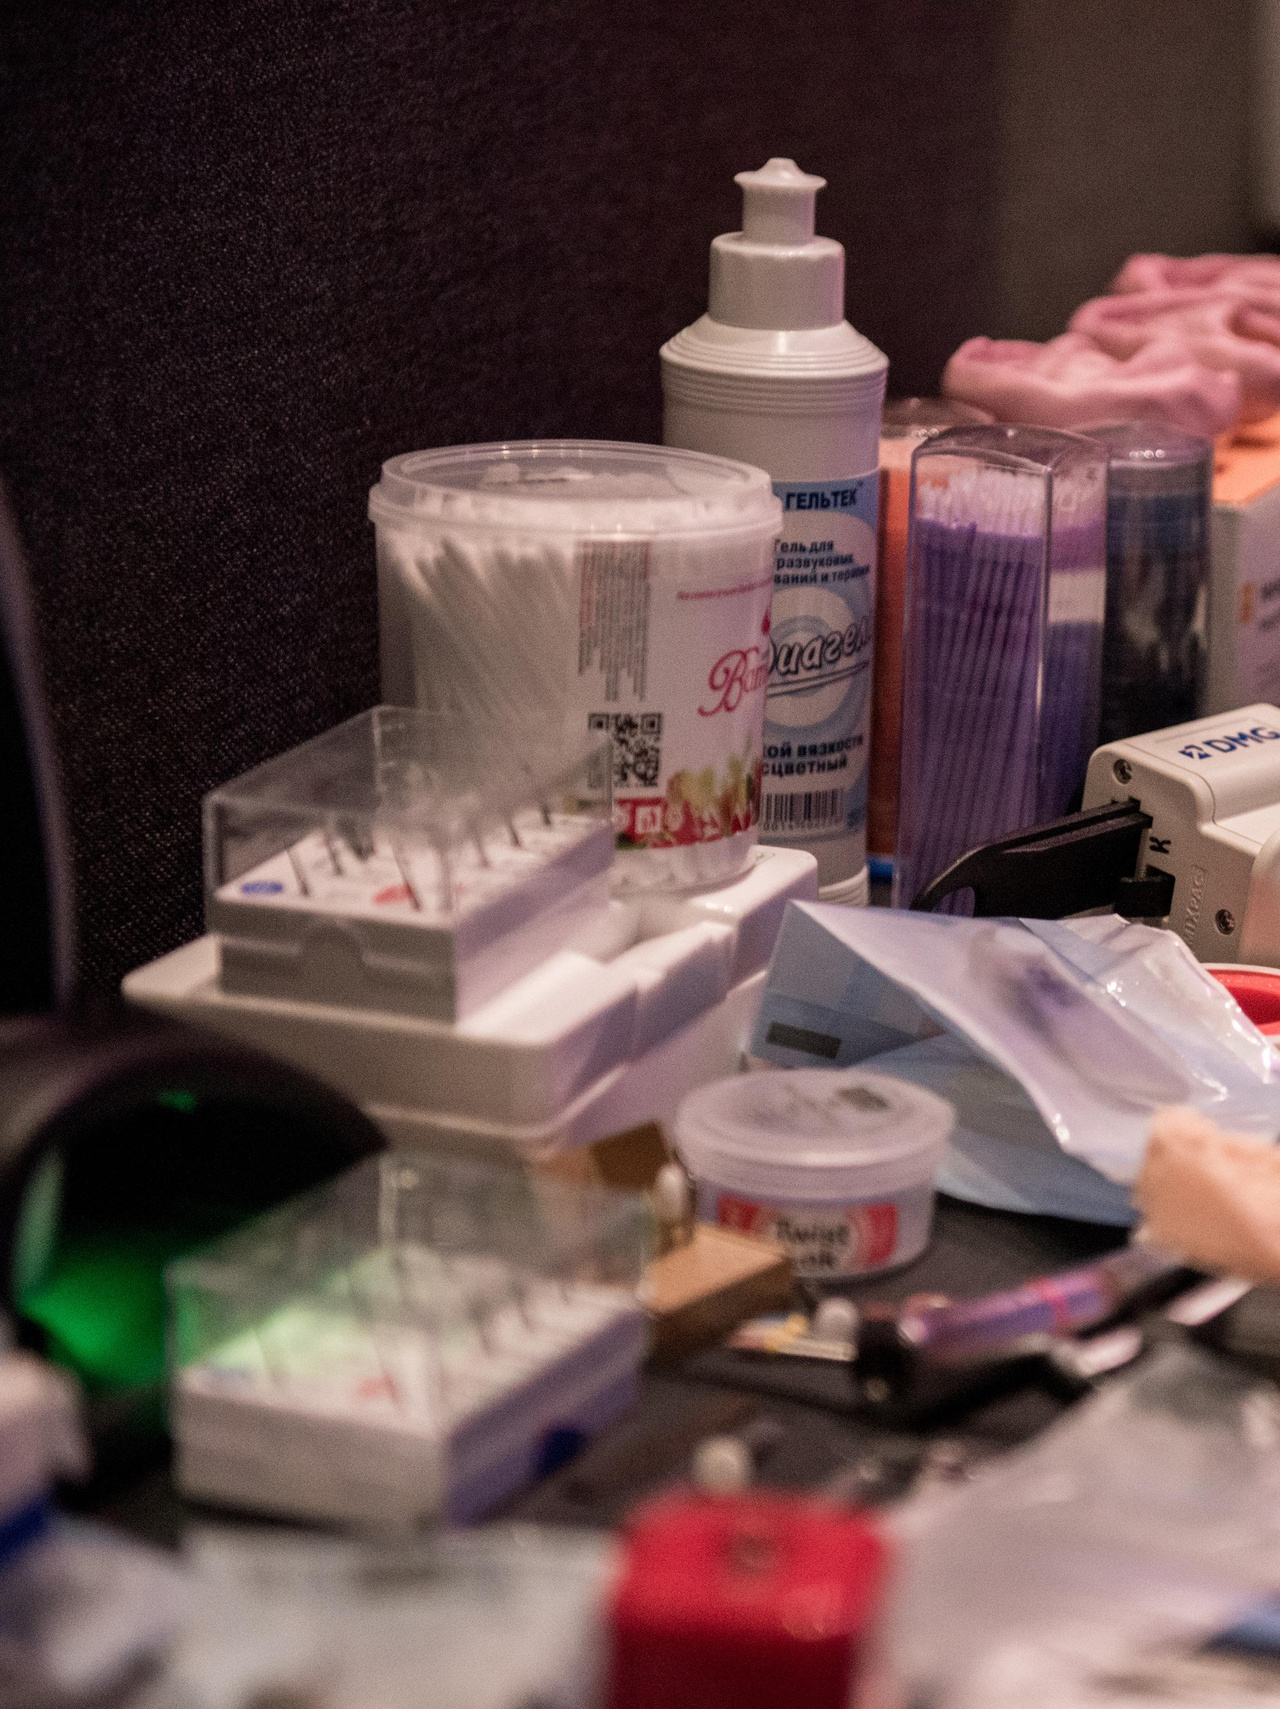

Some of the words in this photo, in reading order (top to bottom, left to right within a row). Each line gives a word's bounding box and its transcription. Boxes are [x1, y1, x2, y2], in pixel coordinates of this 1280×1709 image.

[785, 488, 857, 510] ГЕЛЬТЕК
[774, 539, 806, 553] Гель
[809, 540, 834, 554] для
[776, 553, 854, 571] развуковых
[773, 572, 817, 584] ваний
[821, 573, 828, 584] и
[763, 741, 792, 759] ой
[763, 752, 848, 777] сцветный
